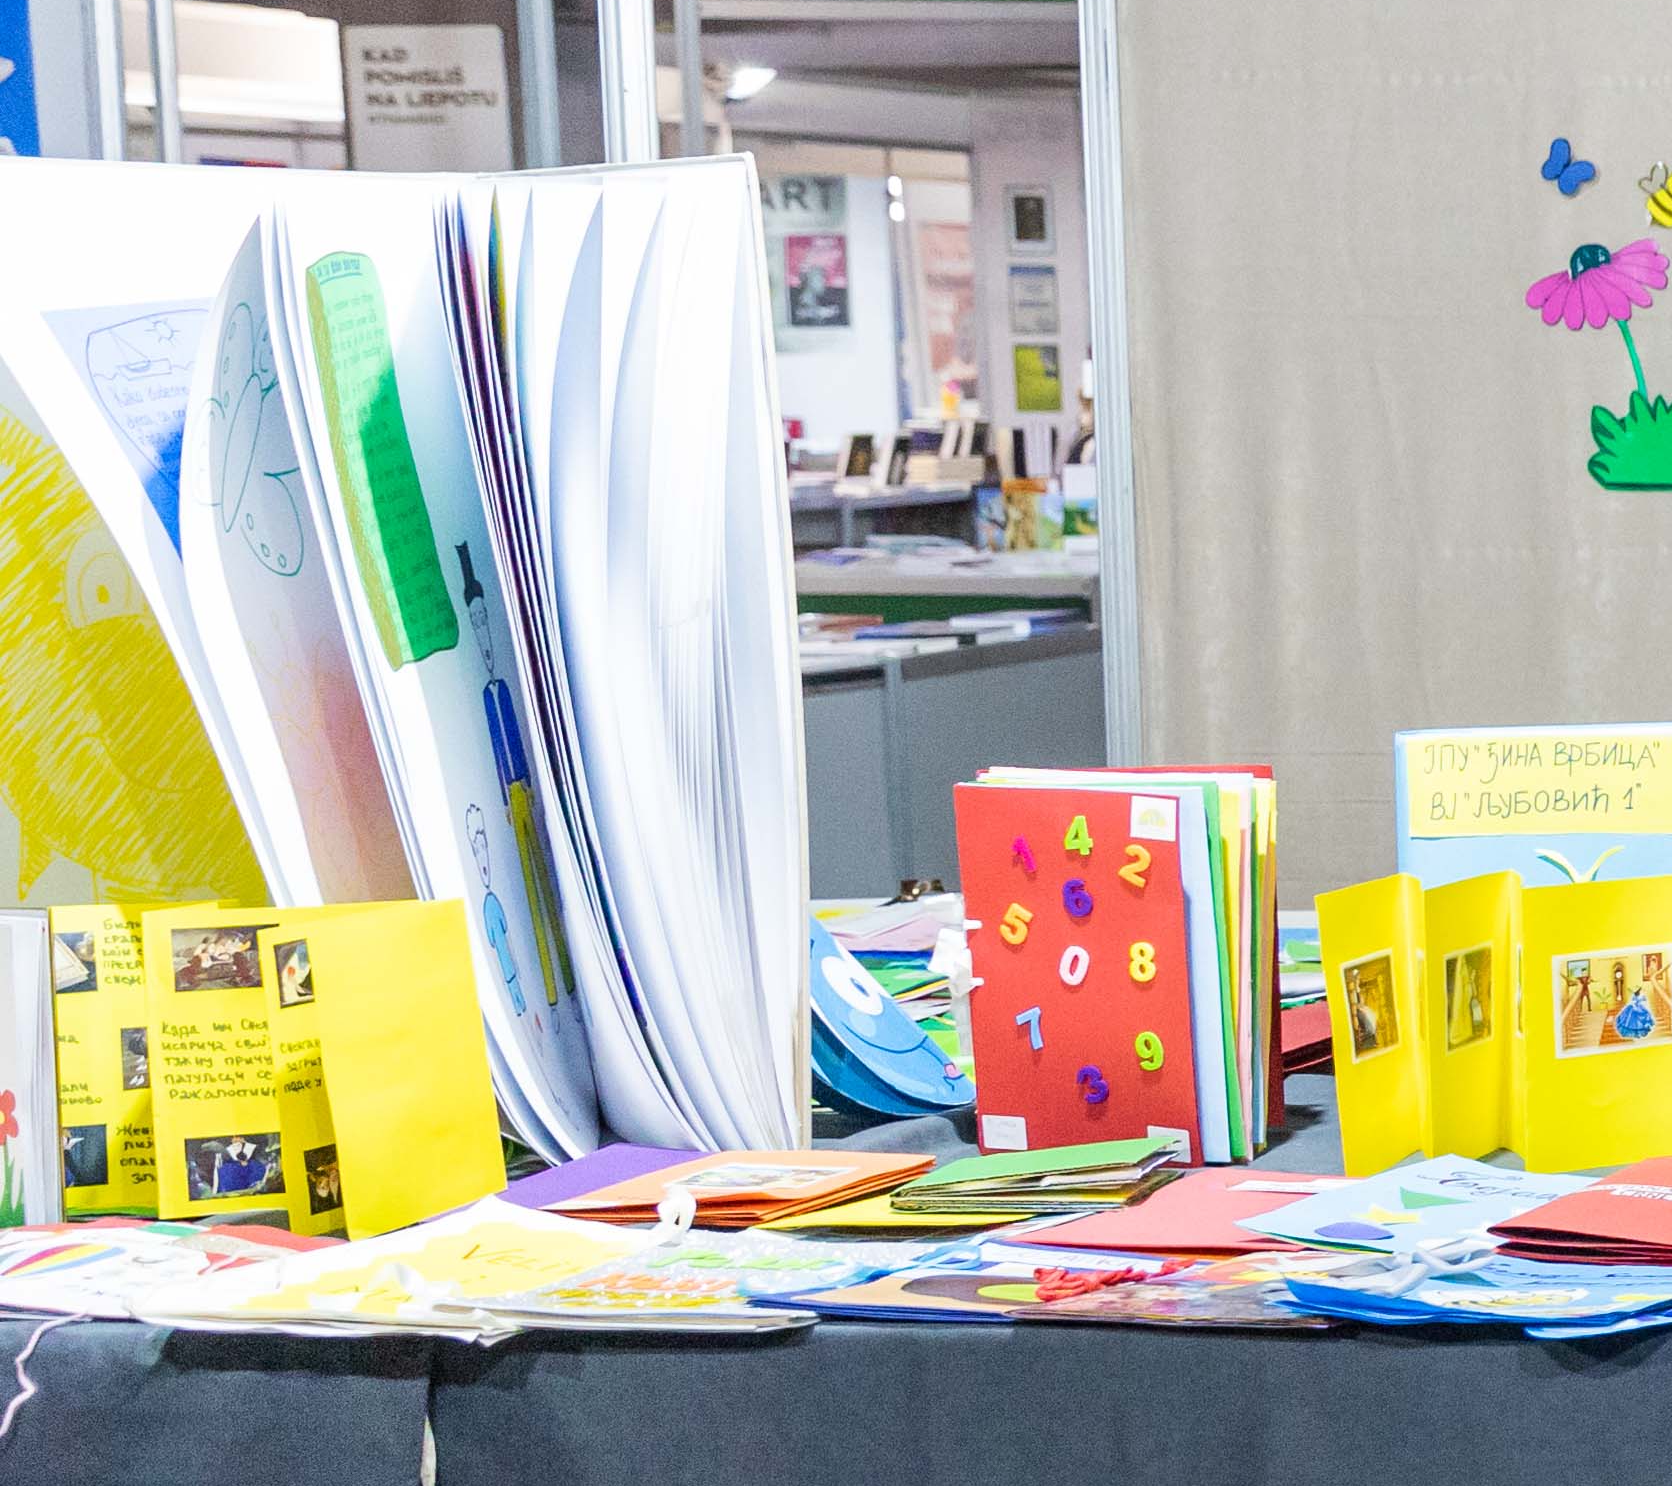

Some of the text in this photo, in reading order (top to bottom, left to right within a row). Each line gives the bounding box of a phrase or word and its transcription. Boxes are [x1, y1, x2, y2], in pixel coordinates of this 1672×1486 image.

[362, 49, 408, 62] KAD
[367, 93, 397, 106] NA
[1424, 743, 1471, 775] ЈПУ
[1553, 740, 1661, 778] ВРБИЦА"
[1012, 834, 1037, 872] 1
[1064, 815, 1093, 856] 4
[1118, 844, 1151, 888] 2
[1062, 878, 1093, 917] 6
[1000, 902, 1033, 945] 5
[1058, 945, 1090, 986] 0
[1128, 942, 1157, 983] 8
[1015, 1006, 1044, 1051] 7
[1135, 1031, 1164, 1072] 9
[1077, 1065, 1109, 1104] 3
